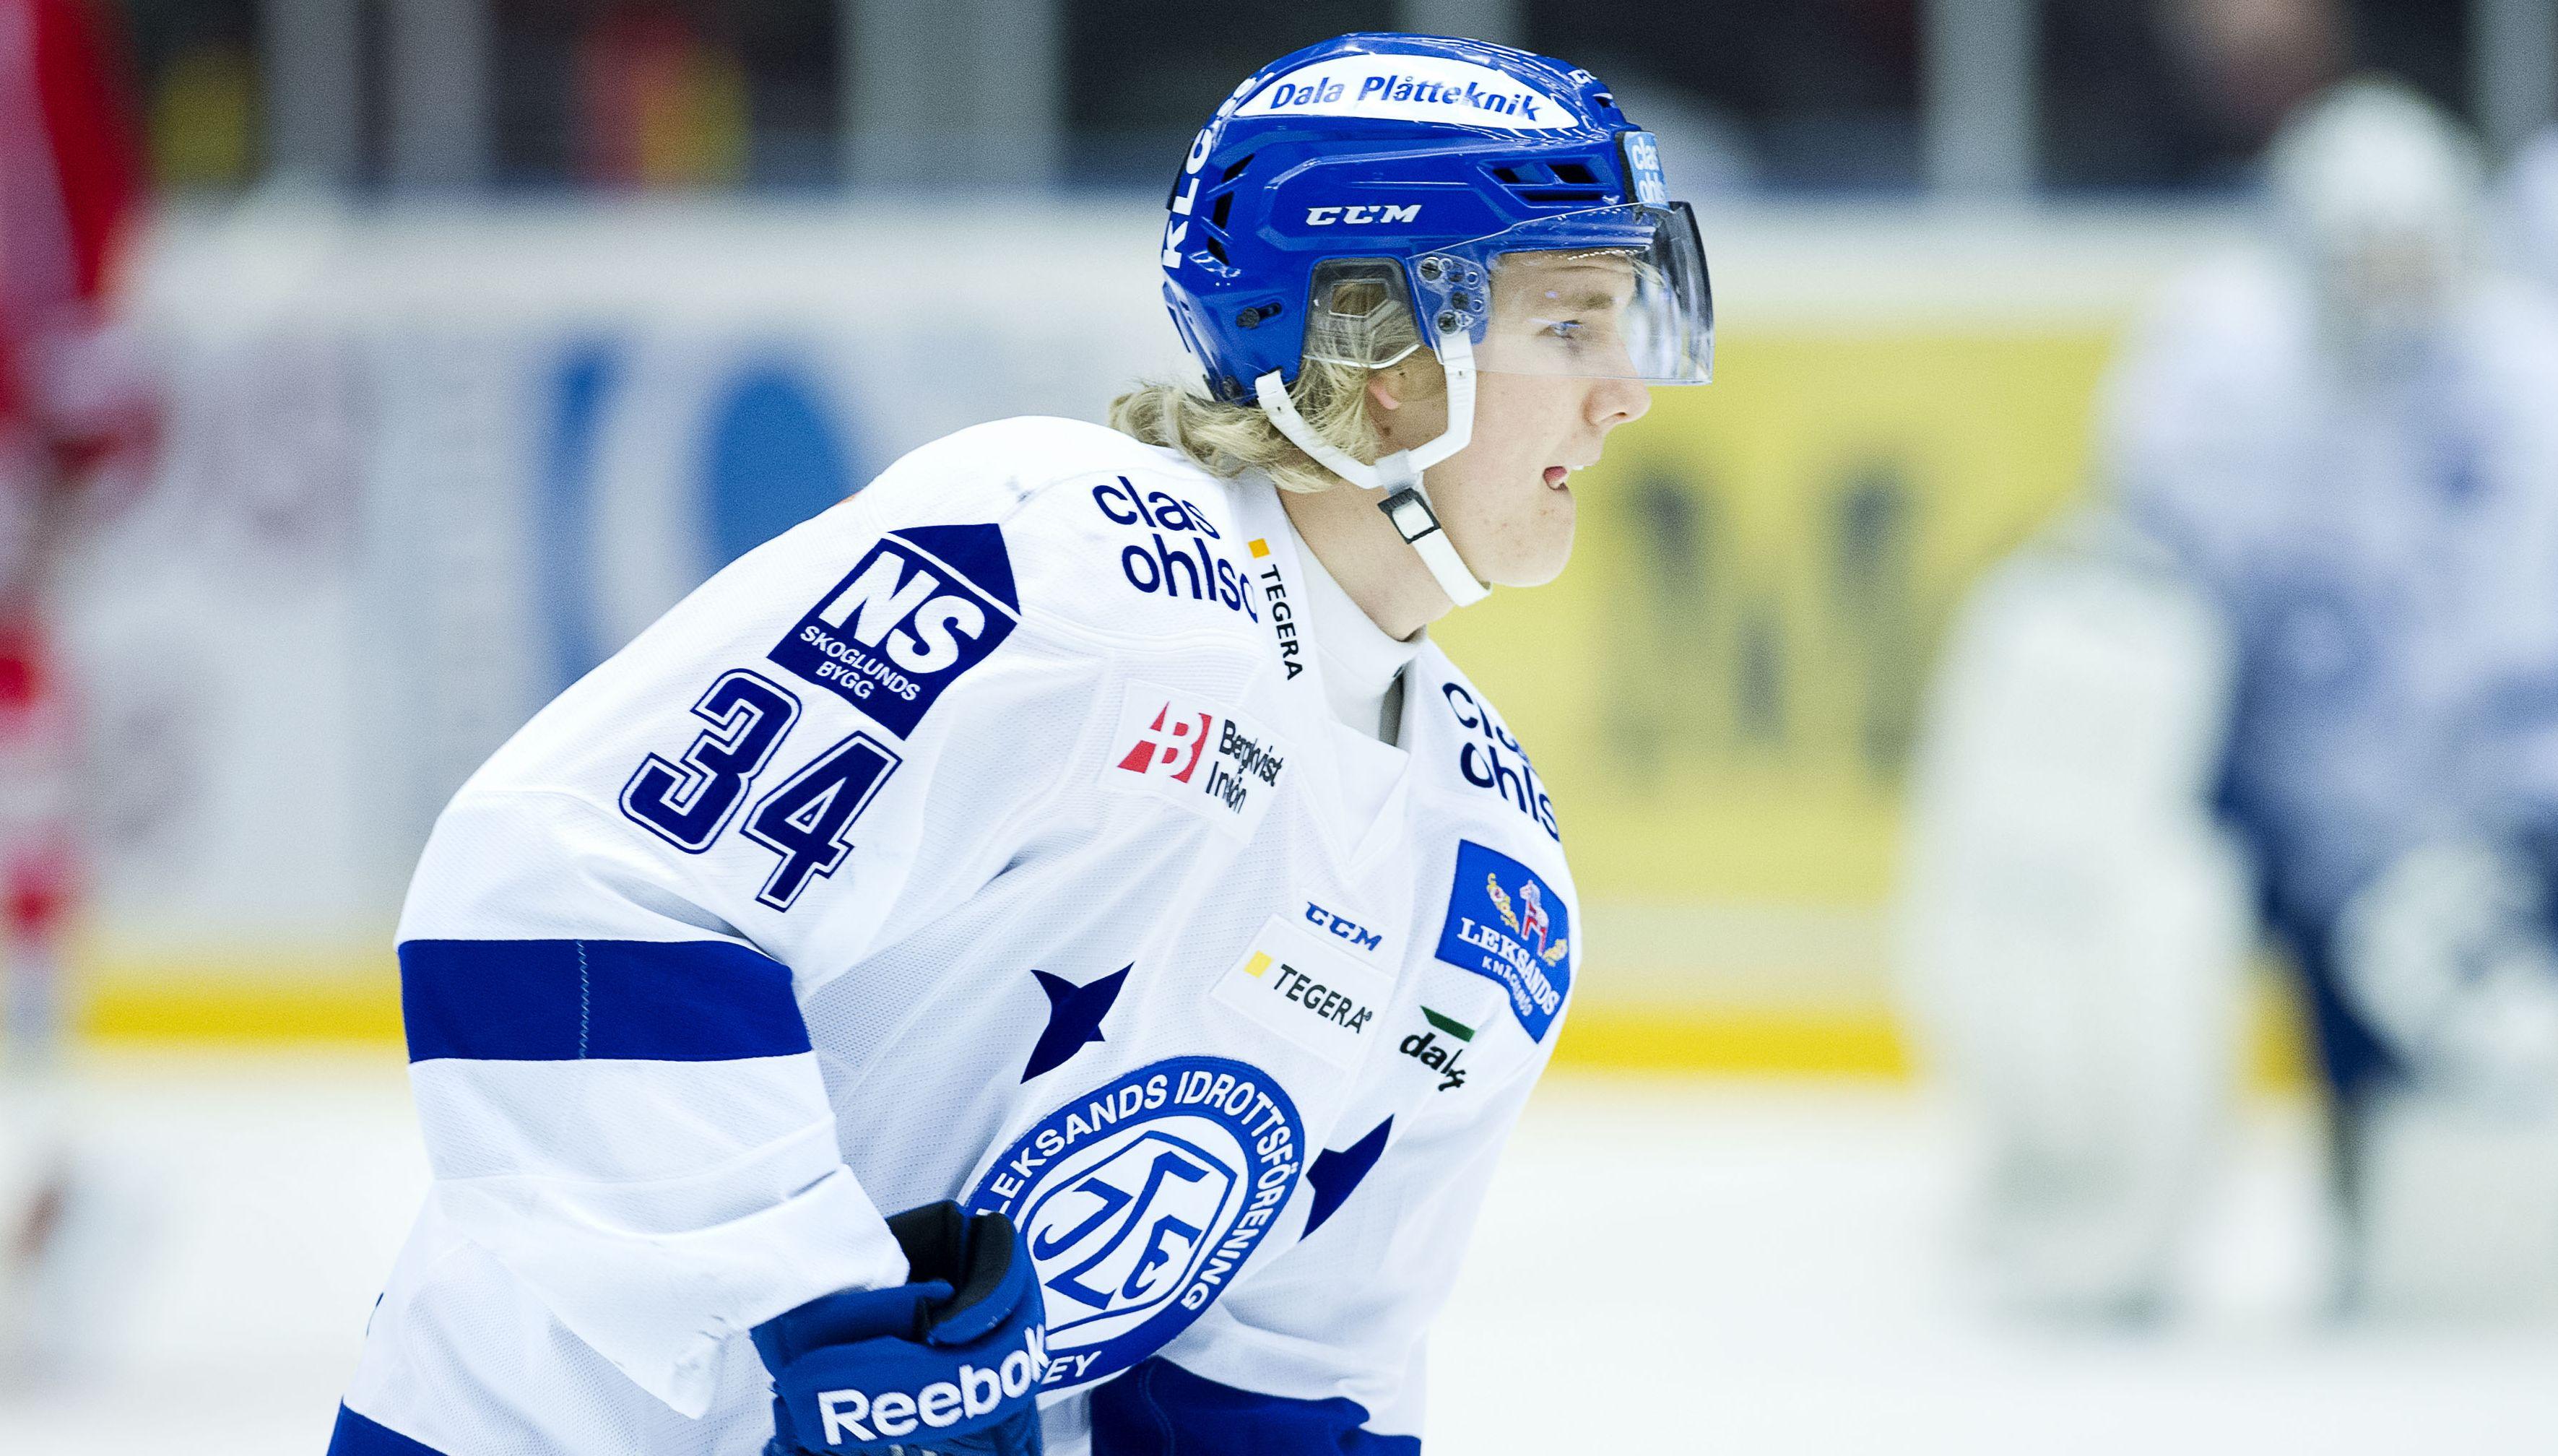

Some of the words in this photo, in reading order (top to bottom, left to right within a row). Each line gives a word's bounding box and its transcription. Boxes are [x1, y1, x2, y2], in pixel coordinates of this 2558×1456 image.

[1270, 77, 1344, 109] Dala
[1357, 74, 1543, 121] Plåtteknik
[1306, 204, 1421, 226] CCM
[1093, 475, 1221, 540] clas
[819, 550, 986, 674] NS
[1259, 563, 1303, 680] TEGERA
[799, 625, 921, 702] SKOGLUNDS
[815, 661, 872, 700] BYGG
[618, 667, 903, 914] 34
[1304, 901, 1382, 951] CCM
[1457, 916, 1561, 1015] LEKSANDS
[976, 1074, 1167, 1218] LEKSANDS
[1174, 1070, 1299, 1311] IDROTTSFÖRENING
[818, 1322, 1052, 1445] Reebok
